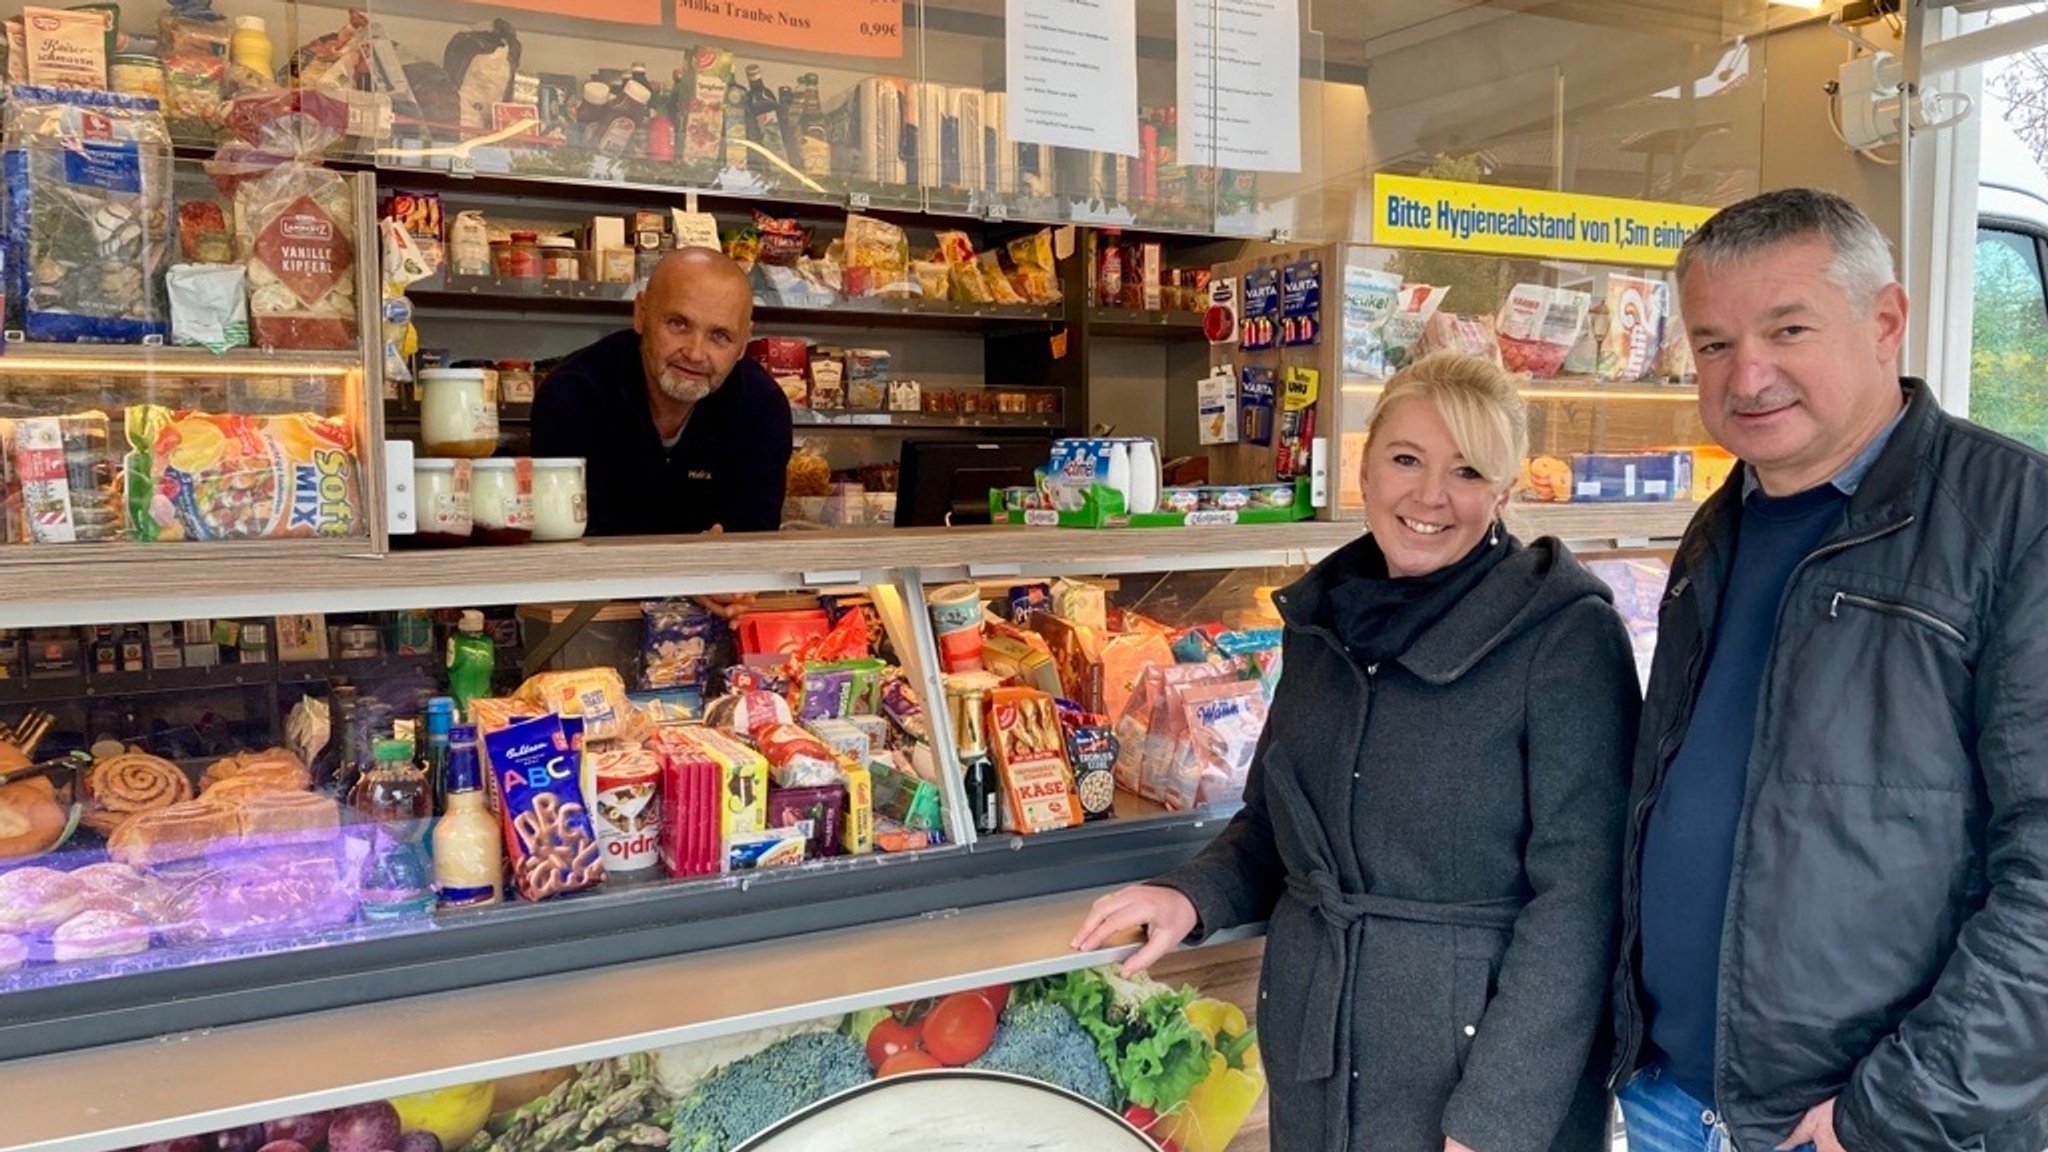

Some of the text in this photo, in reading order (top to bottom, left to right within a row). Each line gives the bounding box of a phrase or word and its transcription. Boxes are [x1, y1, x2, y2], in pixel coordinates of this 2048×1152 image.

[724, 2, 774, 24] Traube
[778, 12, 811, 29] Nuss
[859, 22, 898, 37] 0,99€
[1387, 195, 1699, 249] Bitte Hygieneabstand von 1,5m einh
[281, 246, 332, 260] VANILLE
[281, 260, 333, 273] KIPFERL
[1246, 286, 1277, 298] VARTA
[1284, 279, 1318, 292] VARTA
[1242, 382, 1273, 395] VARTA
[1288, 382, 1307, 394] UHU
[293, 465, 318, 527] MIX
[504, 756, 571, 793] ABC
